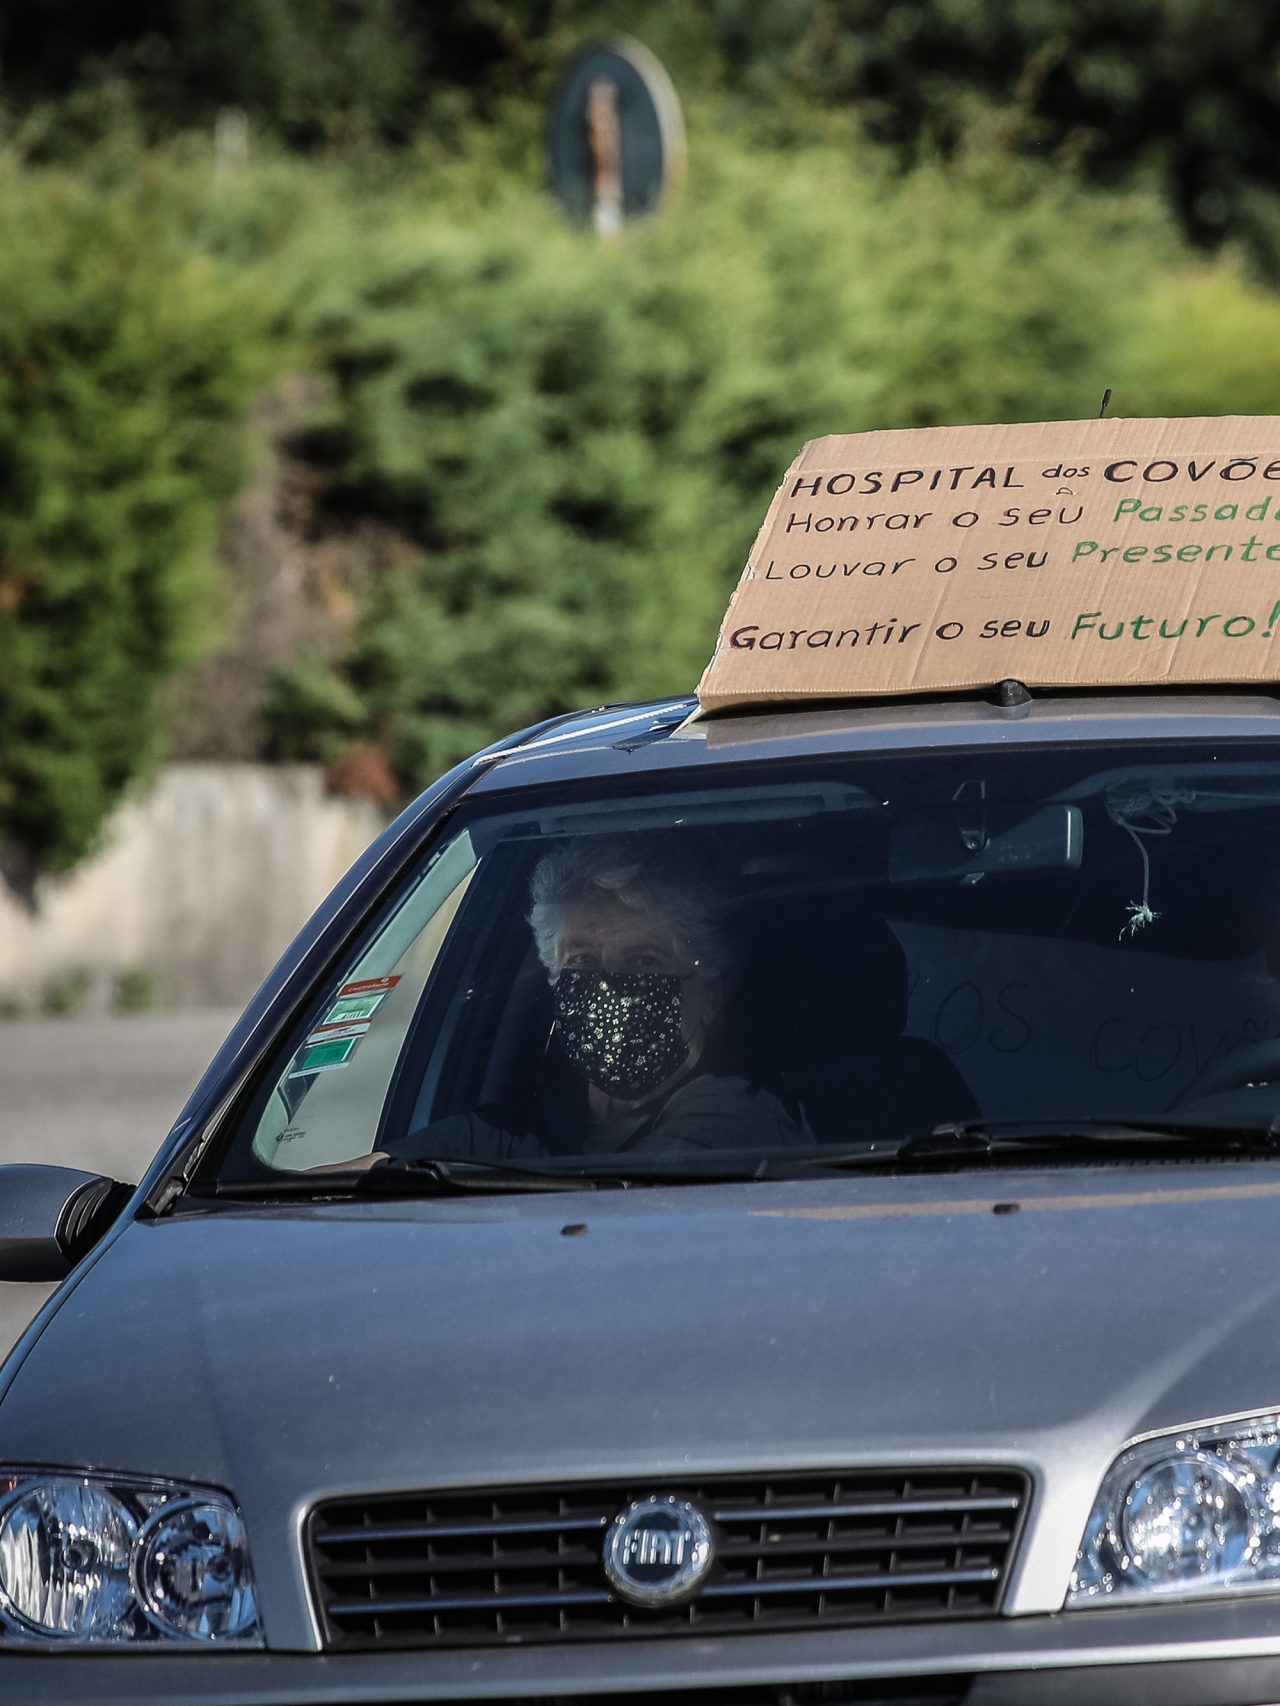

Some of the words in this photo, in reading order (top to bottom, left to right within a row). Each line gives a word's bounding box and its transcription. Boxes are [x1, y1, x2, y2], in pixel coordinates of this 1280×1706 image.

[790, 466, 1025, 498] HOSPITAL
[1041, 463, 1091, 479] dos
[785, 512, 934, 534] Honrar
[955, 511, 980, 529] o
[764, 559, 917, 581] Louvar
[934, 556, 958, 574] o
[976, 549, 1049, 571] seu
[729, 618, 921, 651] Garantir
[935, 621, 964, 641] o
[978, 617, 1051, 639] seu
